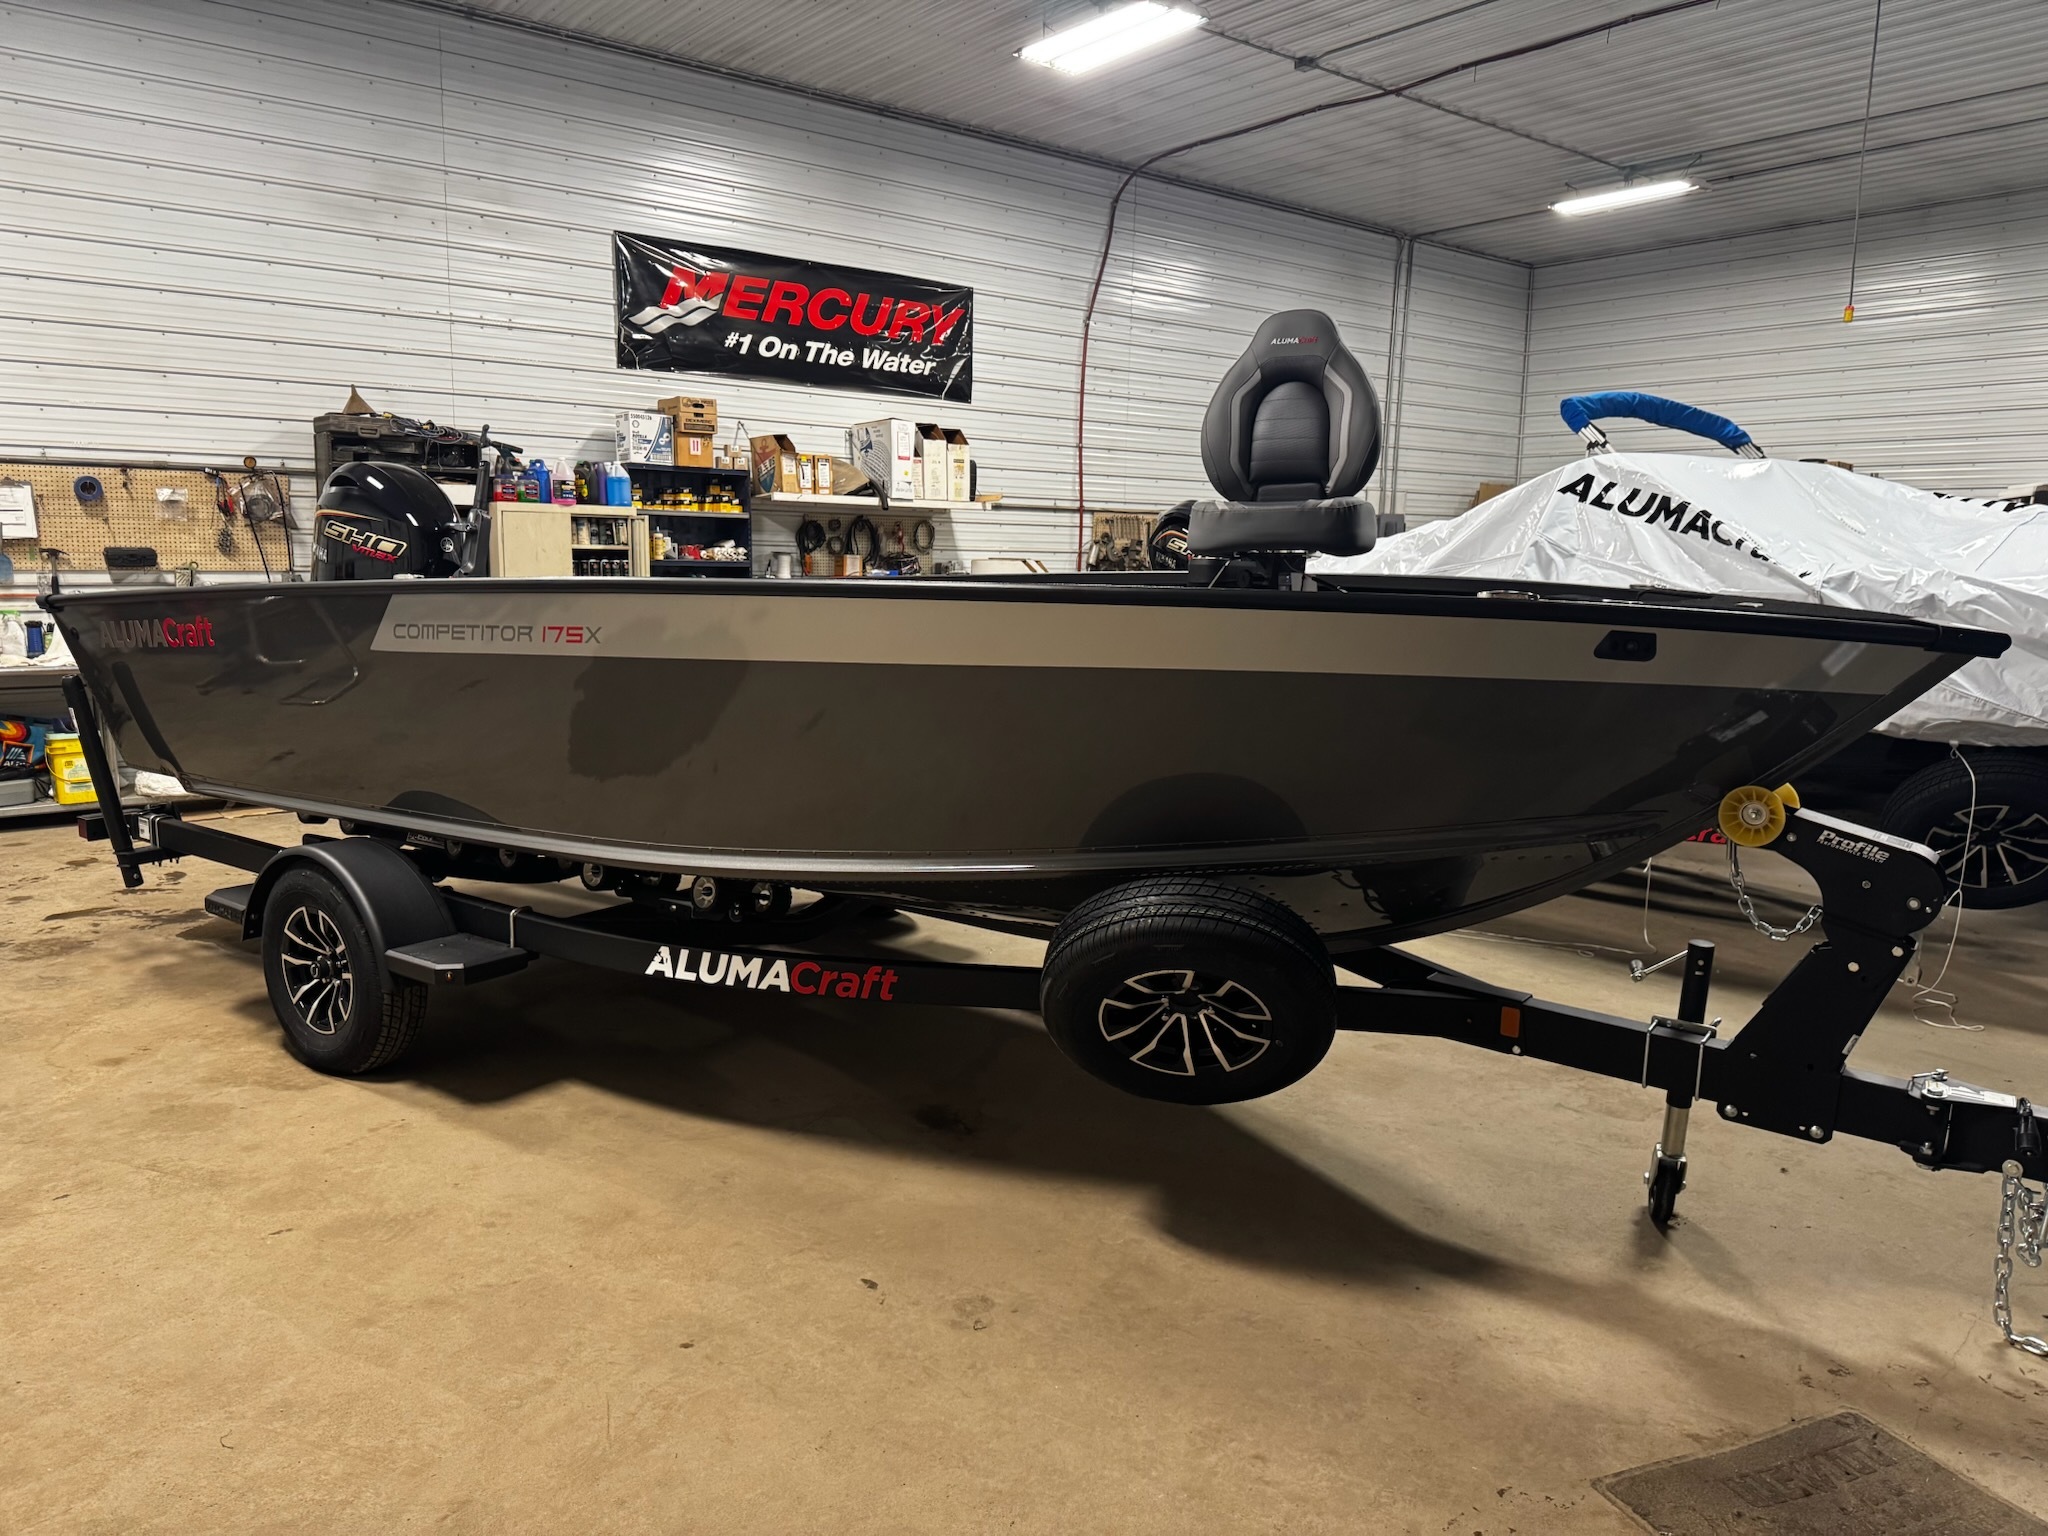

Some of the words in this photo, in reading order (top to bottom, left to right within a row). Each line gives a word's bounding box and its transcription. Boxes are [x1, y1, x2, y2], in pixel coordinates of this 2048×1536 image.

[660, 265, 965, 346] MERCURY
[724, 331, 753, 354] #1
[758, 335, 800, 360] On
[805, 340, 855, 367] The
[861, 347, 937, 376] Water
[324, 520, 407, 556] SHO
[100, 615, 215, 649] ALUMACraft
[393, 623, 533, 642] COMPETITOR
[541, 625, 602, 644] 175X
[1818, 829, 1890, 861] Profile
[644, 945, 899, 1001] ALUMACraft
